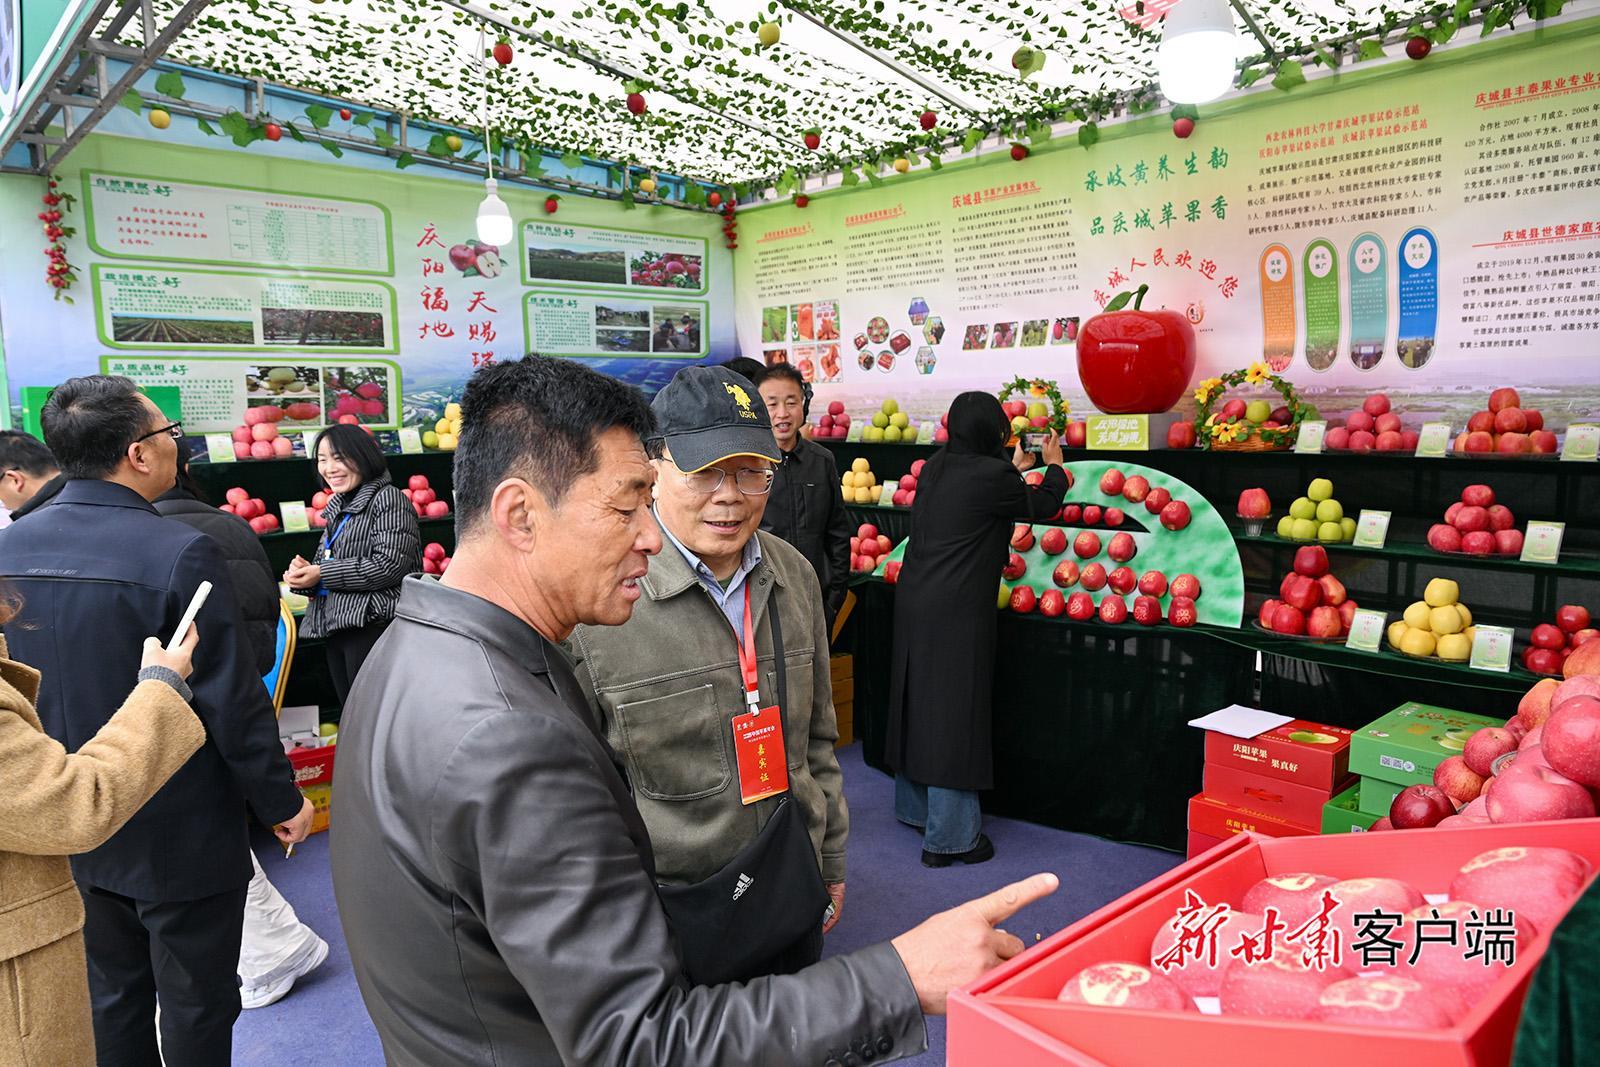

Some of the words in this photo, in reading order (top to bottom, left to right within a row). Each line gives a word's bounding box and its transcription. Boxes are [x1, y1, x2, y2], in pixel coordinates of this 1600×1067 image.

[1084, 146, 1229, 192] 承岐黄养生韵
[1090, 195, 1229, 236] 品庆城苹果香
[416, 223, 454, 341] 庆阳福地
[1233, 743, 1268, 759] 庆阳苹果
[1271, 759, 1299, 773] 果真好
